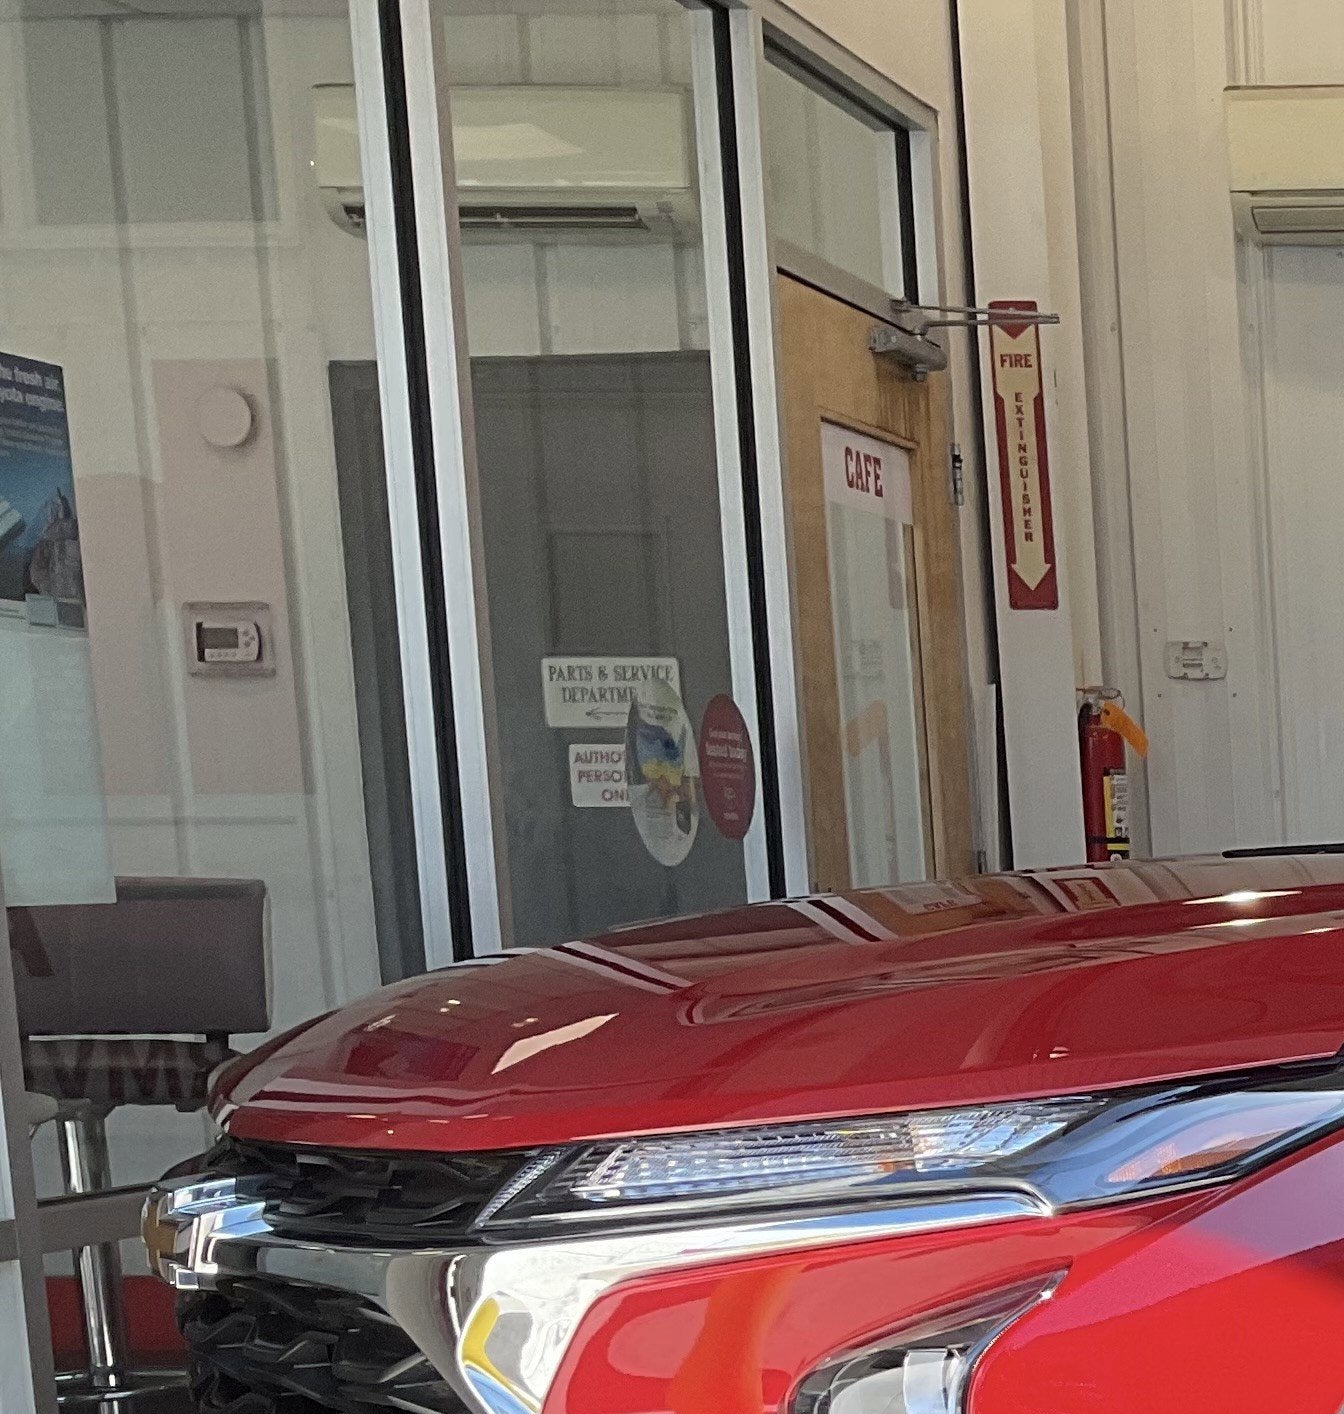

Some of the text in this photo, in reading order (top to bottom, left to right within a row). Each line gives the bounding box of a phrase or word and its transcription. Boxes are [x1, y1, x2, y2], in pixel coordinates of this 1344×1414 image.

[1000, 353, 1033, 369] FIRE
[844, 446, 884, 498] CAFE
[1014, 391, 1034, 543] EXTINGUISHER
[548, 665, 675, 682] PARTS & SERVICE
[561, 686, 639, 703] DEPARTME
[574, 751, 627, 764] AUTHO
[577, 770, 625, 783] PERSO
